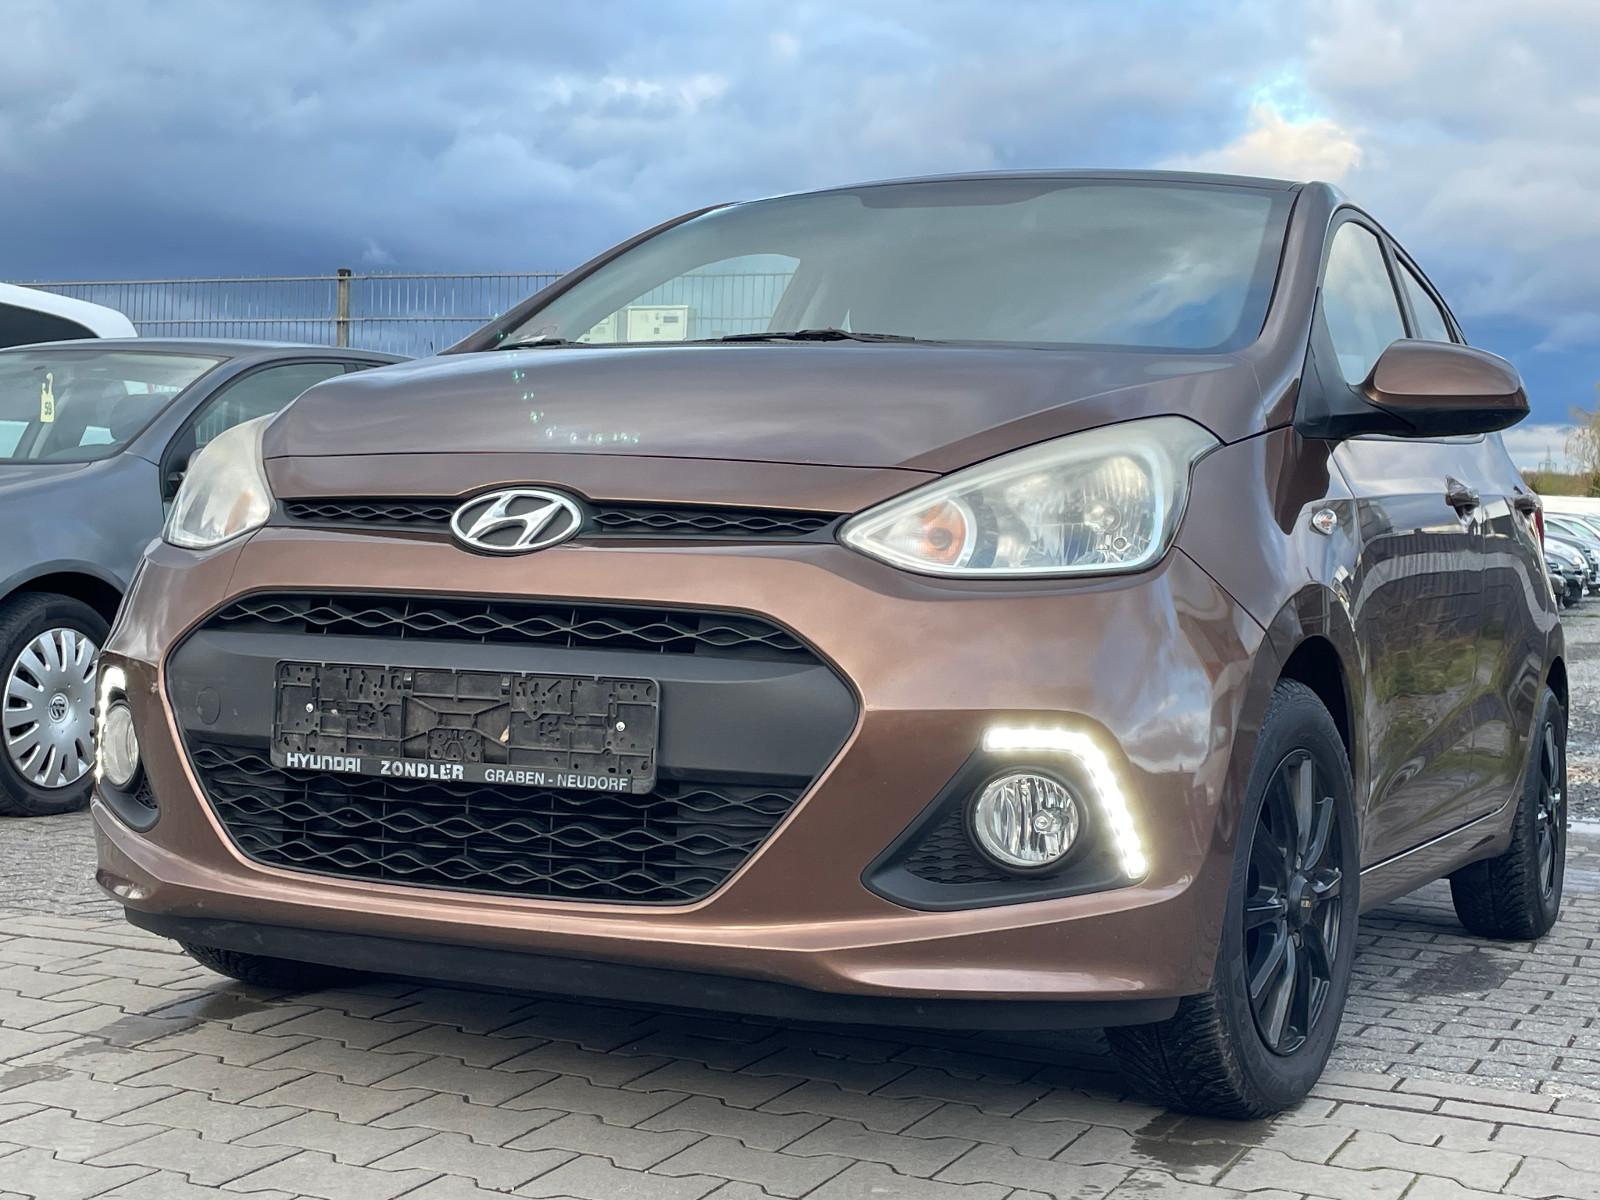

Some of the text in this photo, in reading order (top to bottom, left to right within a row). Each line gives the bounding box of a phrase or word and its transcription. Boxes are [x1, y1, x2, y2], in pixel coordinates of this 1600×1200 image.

[286, 752, 362, 773] HYUNDAI
[380, 760, 465, 780] ZONDLER
[484, 768, 545, 785] GRABEN
[557, 774, 629, 791] NEUDORF
